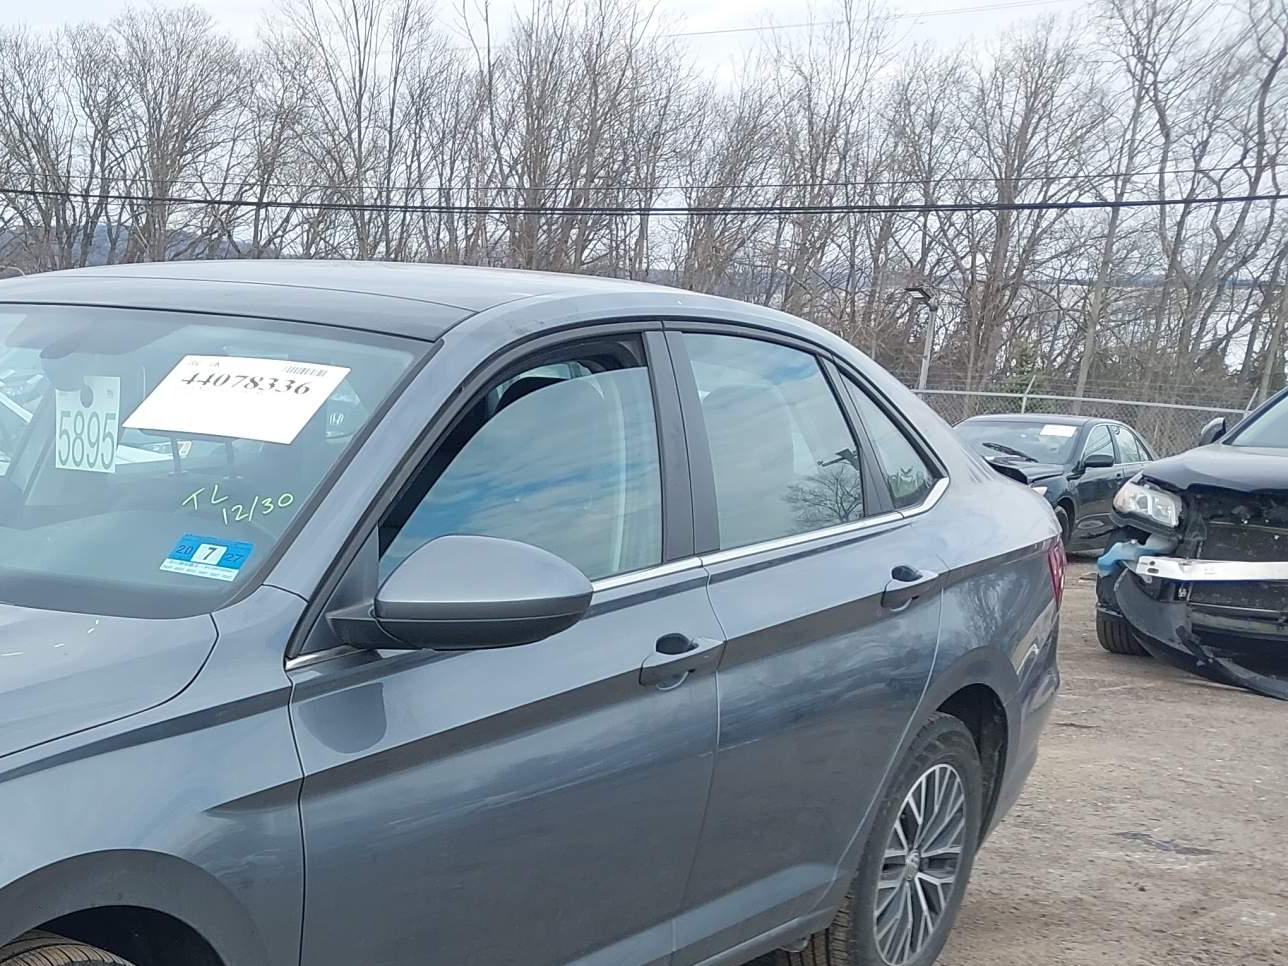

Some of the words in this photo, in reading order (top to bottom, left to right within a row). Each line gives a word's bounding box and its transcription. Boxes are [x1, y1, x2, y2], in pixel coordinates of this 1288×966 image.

[181, 371, 313, 396] 44078336
[58, 410, 116, 470] 5895
[222, 493, 294, 525] 12/30
[202, 547, 217, 561] 7
